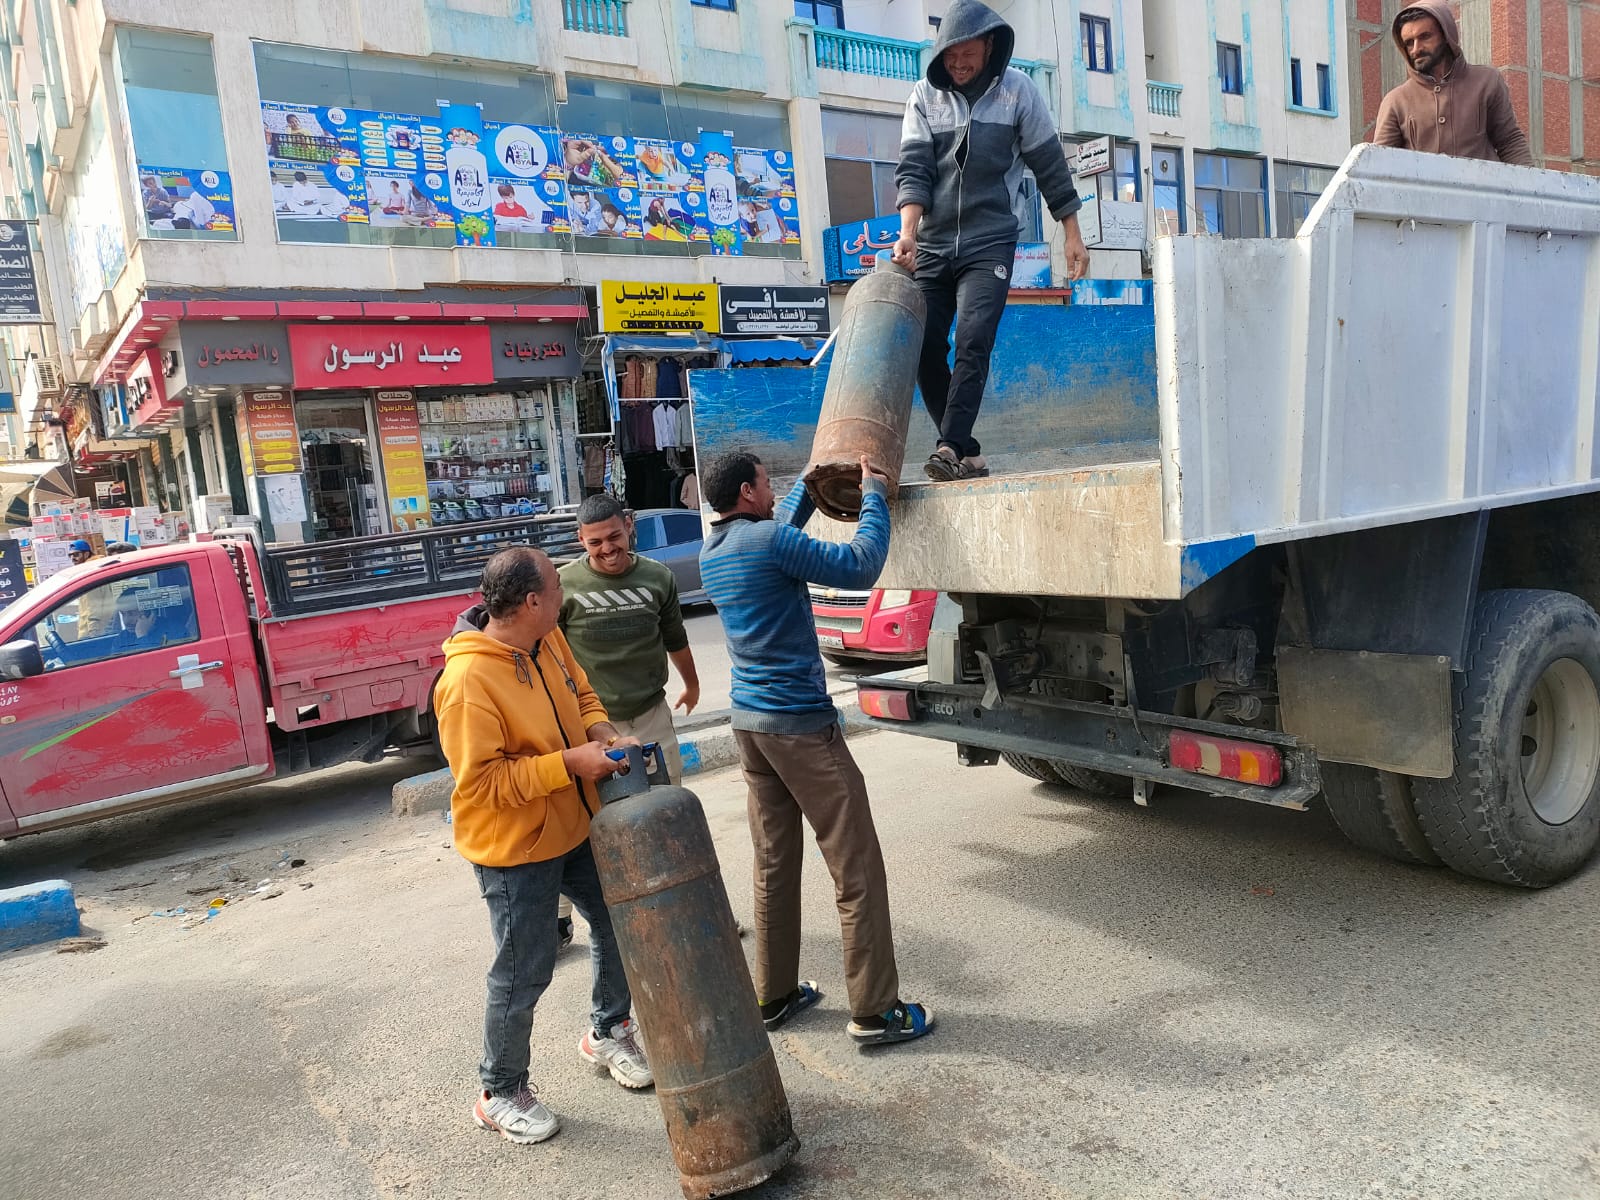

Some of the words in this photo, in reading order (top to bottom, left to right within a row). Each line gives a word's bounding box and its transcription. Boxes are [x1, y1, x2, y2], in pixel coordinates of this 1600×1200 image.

[615, 283, 670, 305] الجليل
[672, 287, 706, 306] عبد
[629, 308, 665, 319] والتفصيل
[665, 306, 696, 318] للأقمشة
[748, 308, 778, 321] والتفصيل
[779, 307, 807, 322] للأقمشة
[198, 342, 279, 368] والمحمول
[324, 341, 403, 373] الرسول
[417, 343, 462, 371] عبد
[505, 340, 567, 364] الكترونيات
